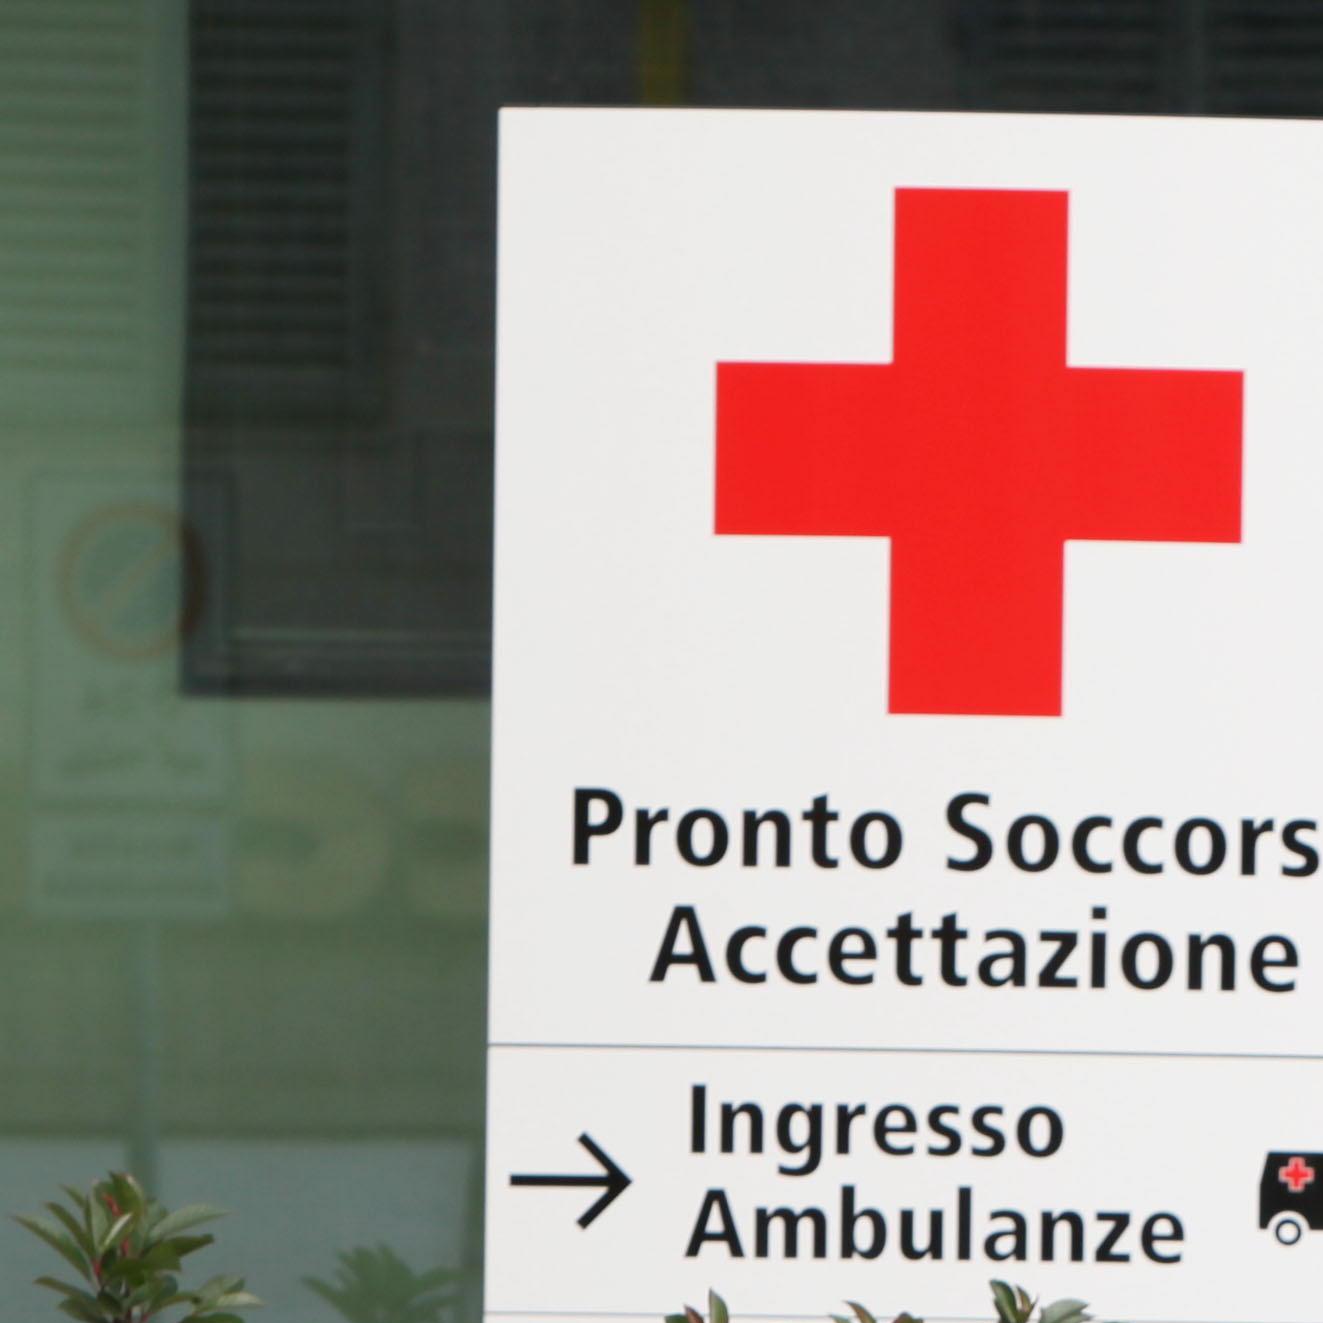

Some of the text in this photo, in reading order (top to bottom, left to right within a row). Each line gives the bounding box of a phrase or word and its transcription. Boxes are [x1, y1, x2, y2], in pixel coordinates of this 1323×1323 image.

[573, 788, 903, 870] Pronto
[649, 905, 1299, 993] Accettazione
[691, 1084, 1064, 1177] Ingresso
[685, 1185, 1185, 1264] Ambulanze
